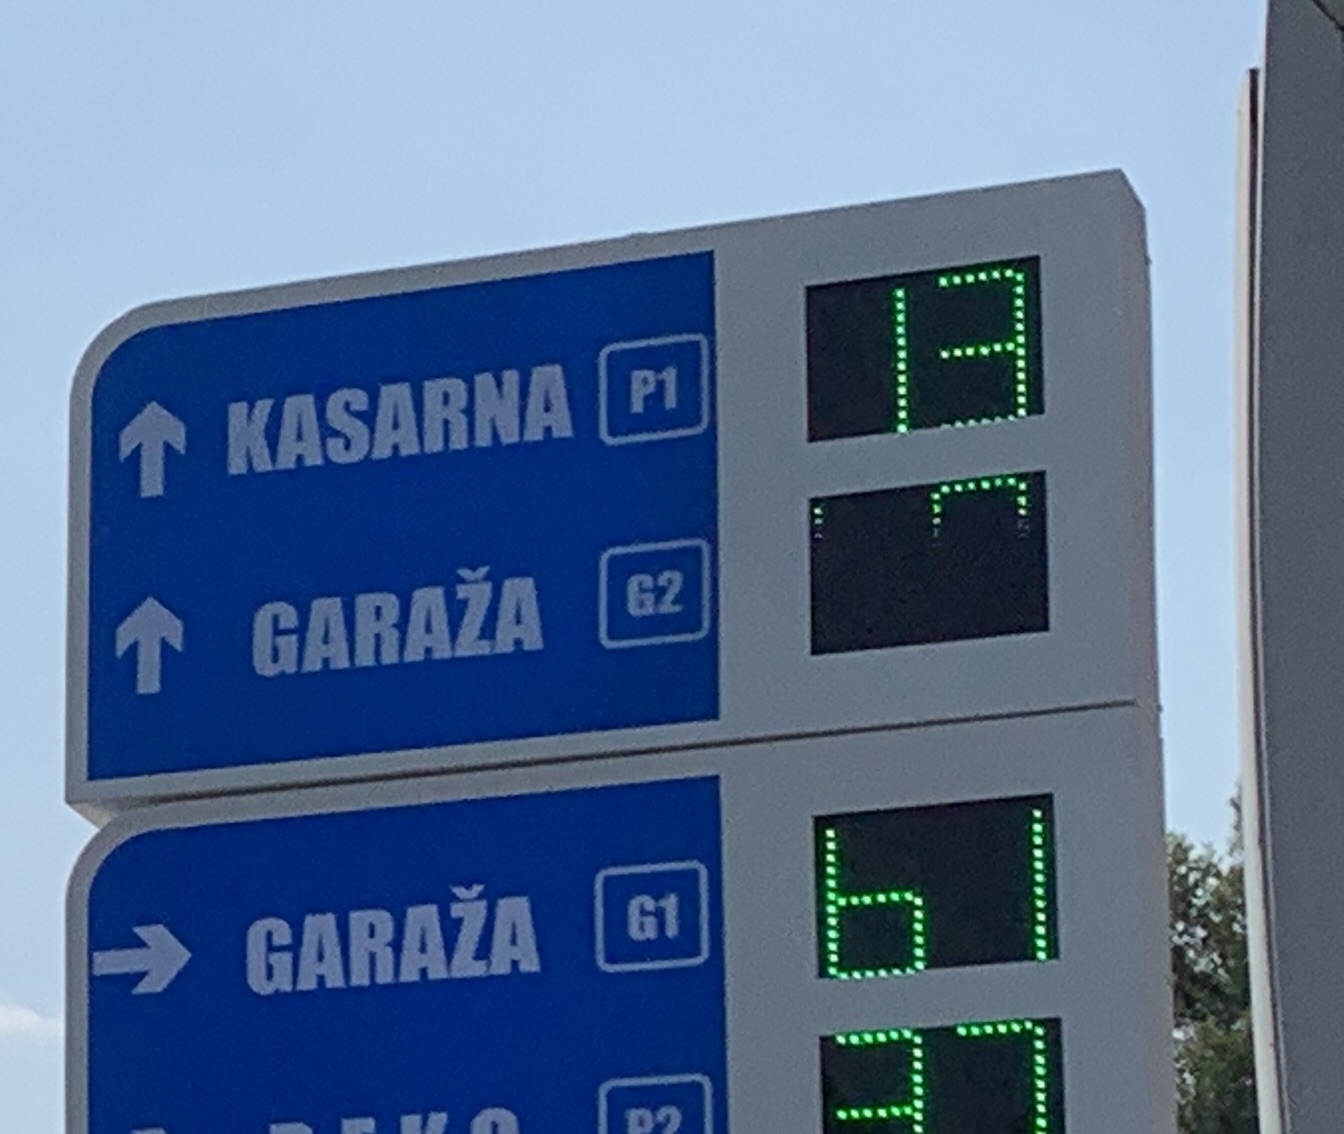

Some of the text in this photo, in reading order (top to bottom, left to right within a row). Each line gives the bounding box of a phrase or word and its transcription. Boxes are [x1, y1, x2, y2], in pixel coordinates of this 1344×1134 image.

[893, 267, 1026, 434] 13
[226, 363, 679, 476] KASARNA P1
[251, 566, 684, 677] GARAŽA G2
[245, 883, 680, 996] GARAŽA G1
